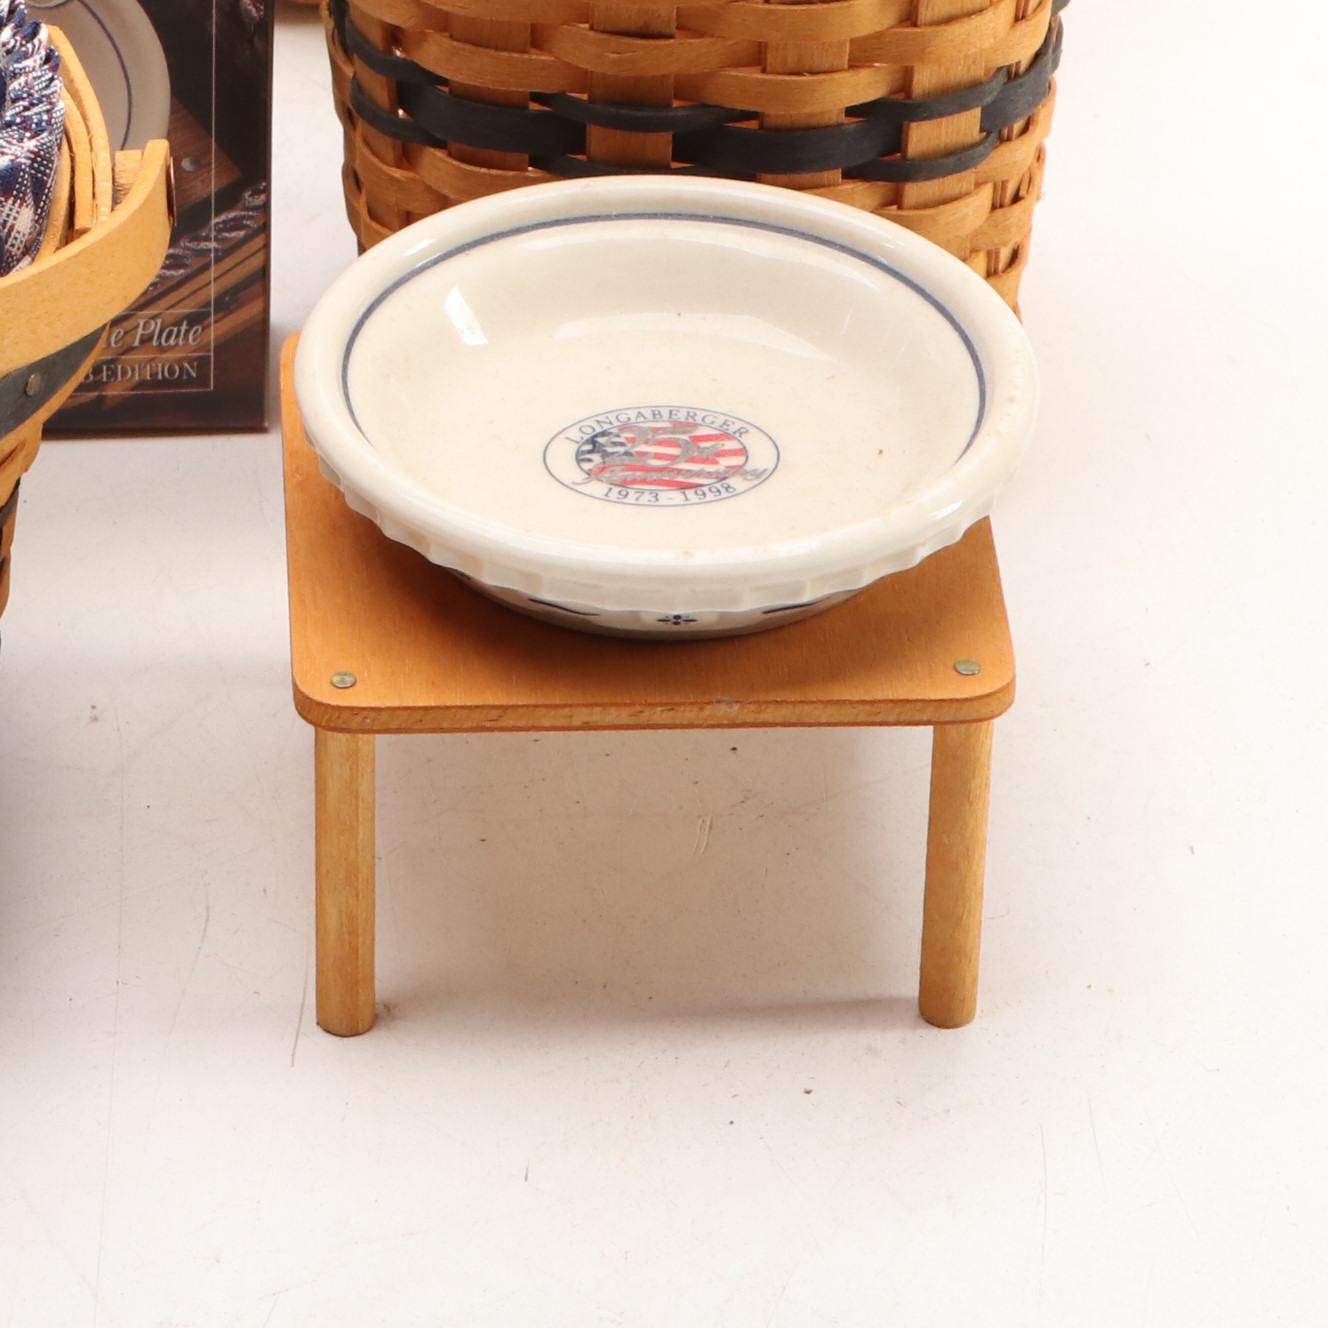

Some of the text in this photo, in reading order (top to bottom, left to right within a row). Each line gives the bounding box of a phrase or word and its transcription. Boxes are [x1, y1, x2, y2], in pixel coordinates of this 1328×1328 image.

[132, 318, 203, 348] Plate
[102, 361, 198, 383] EDITION
[565, 408, 752, 445] LONGABERGER
